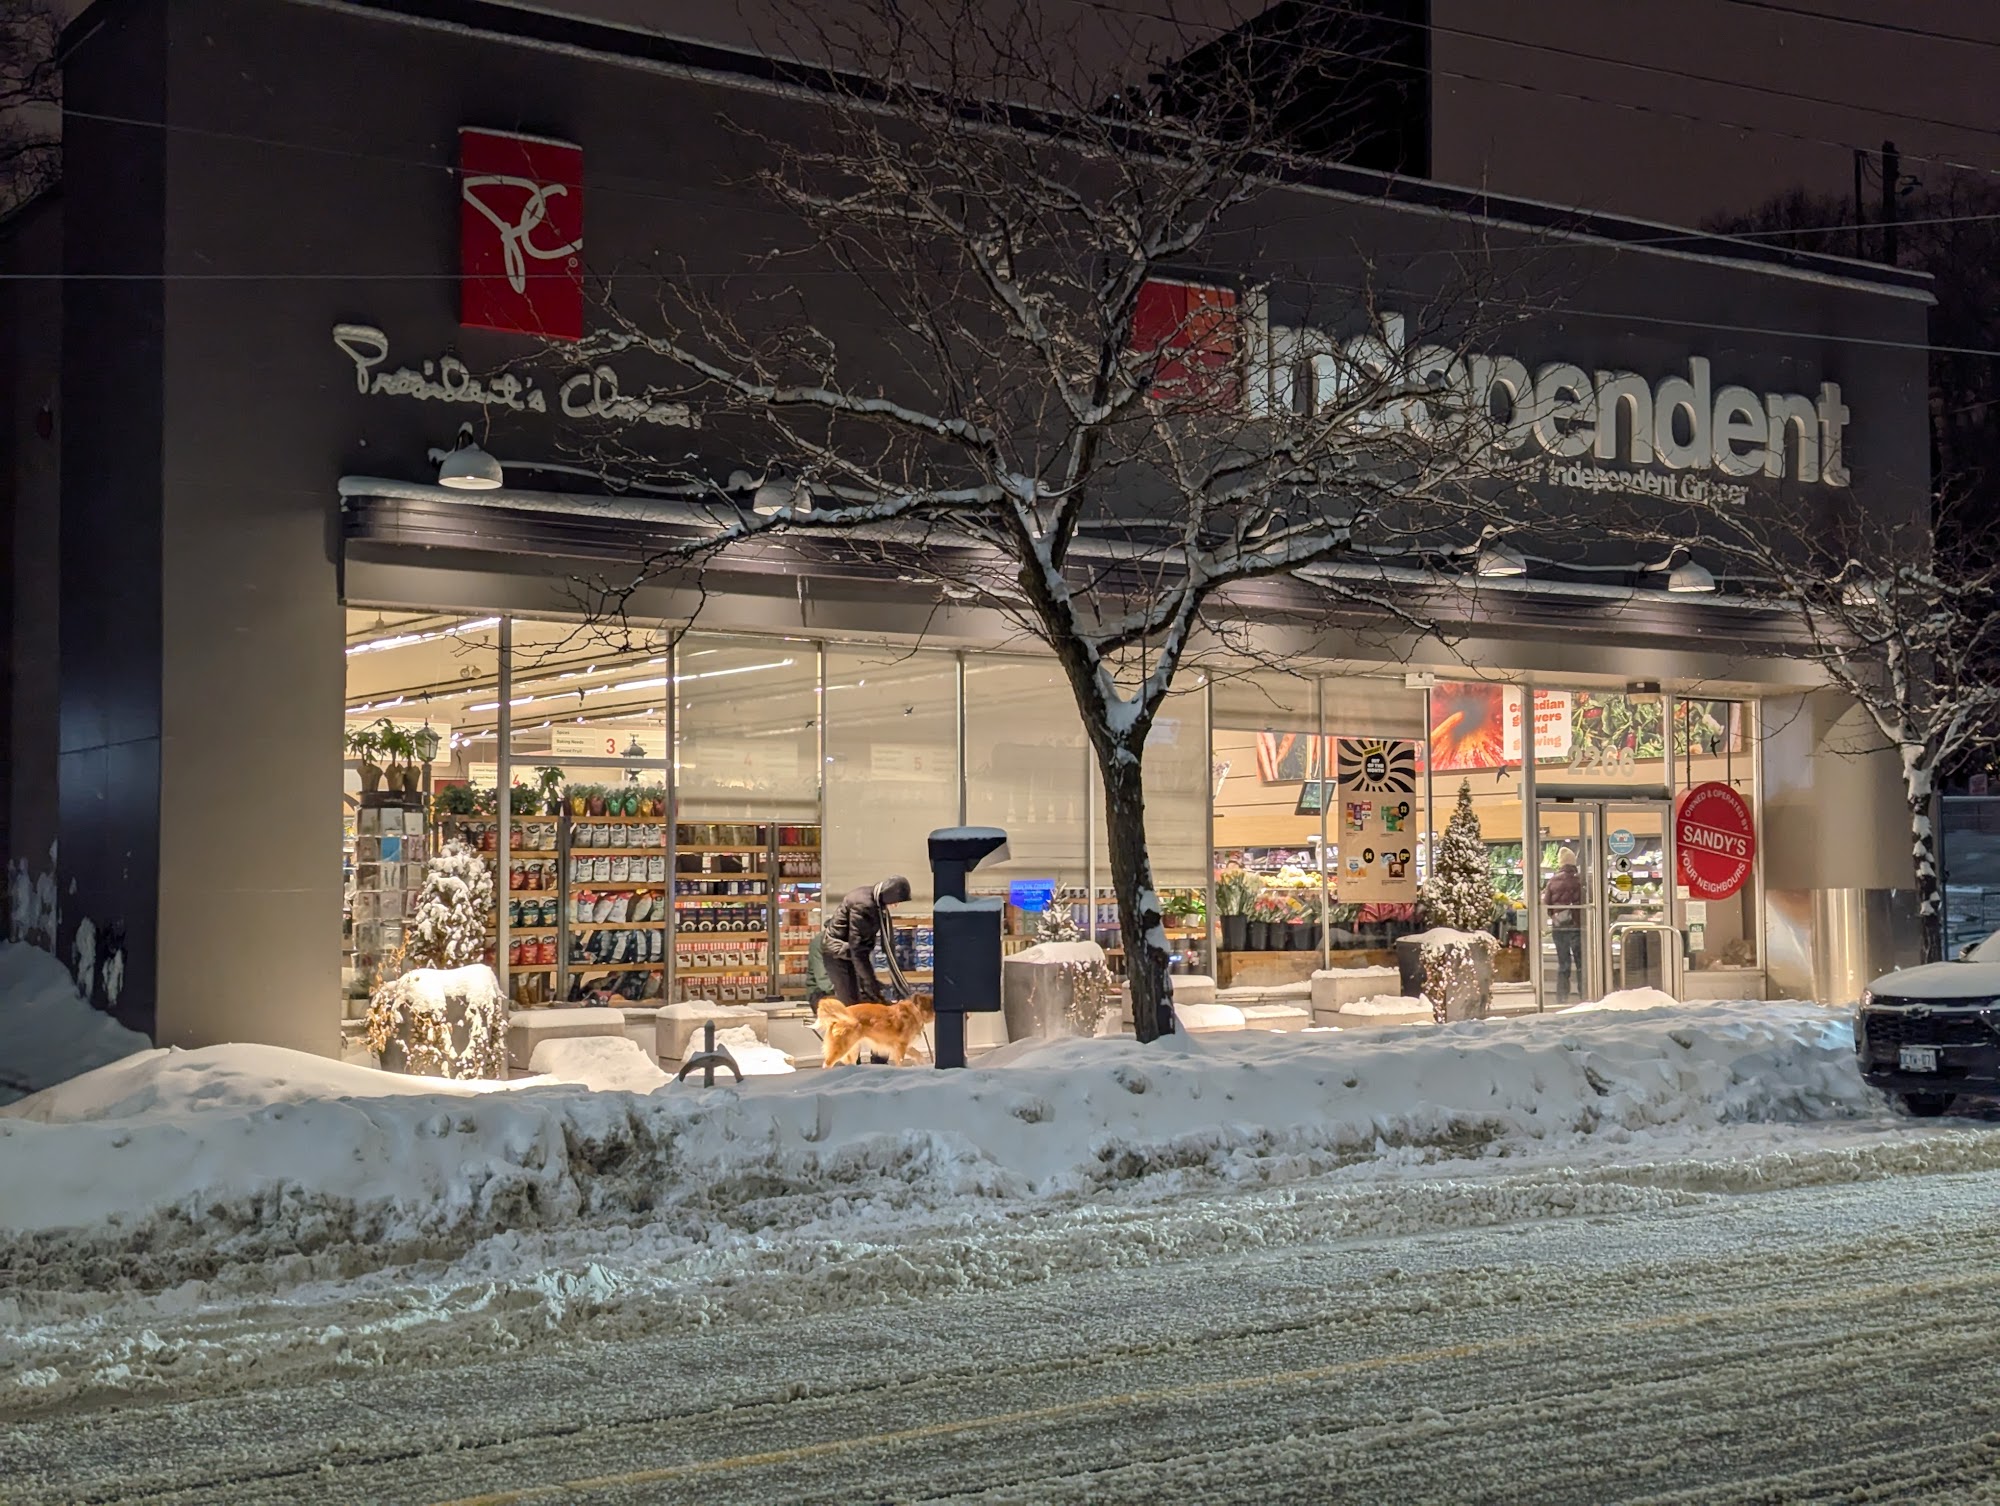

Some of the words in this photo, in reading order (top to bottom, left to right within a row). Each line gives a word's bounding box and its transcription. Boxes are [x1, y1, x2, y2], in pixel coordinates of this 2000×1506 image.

[1244, 284, 1851, 488] Independent
[606, 738, 616, 754] 3
[1567, 744, 1636, 777] 2266
[1684, 792, 1707, 817] OWNED
[1707, 789, 1713, 798] &
[1712, 789, 1745, 818] OPERATED
[1740, 816, 1749, 831] BY
[1683, 825, 1747, 856] SANDY'S
[1681, 849, 1698, 880] YOUR
[1696, 862, 1746, 892] NEIGHBOURS
